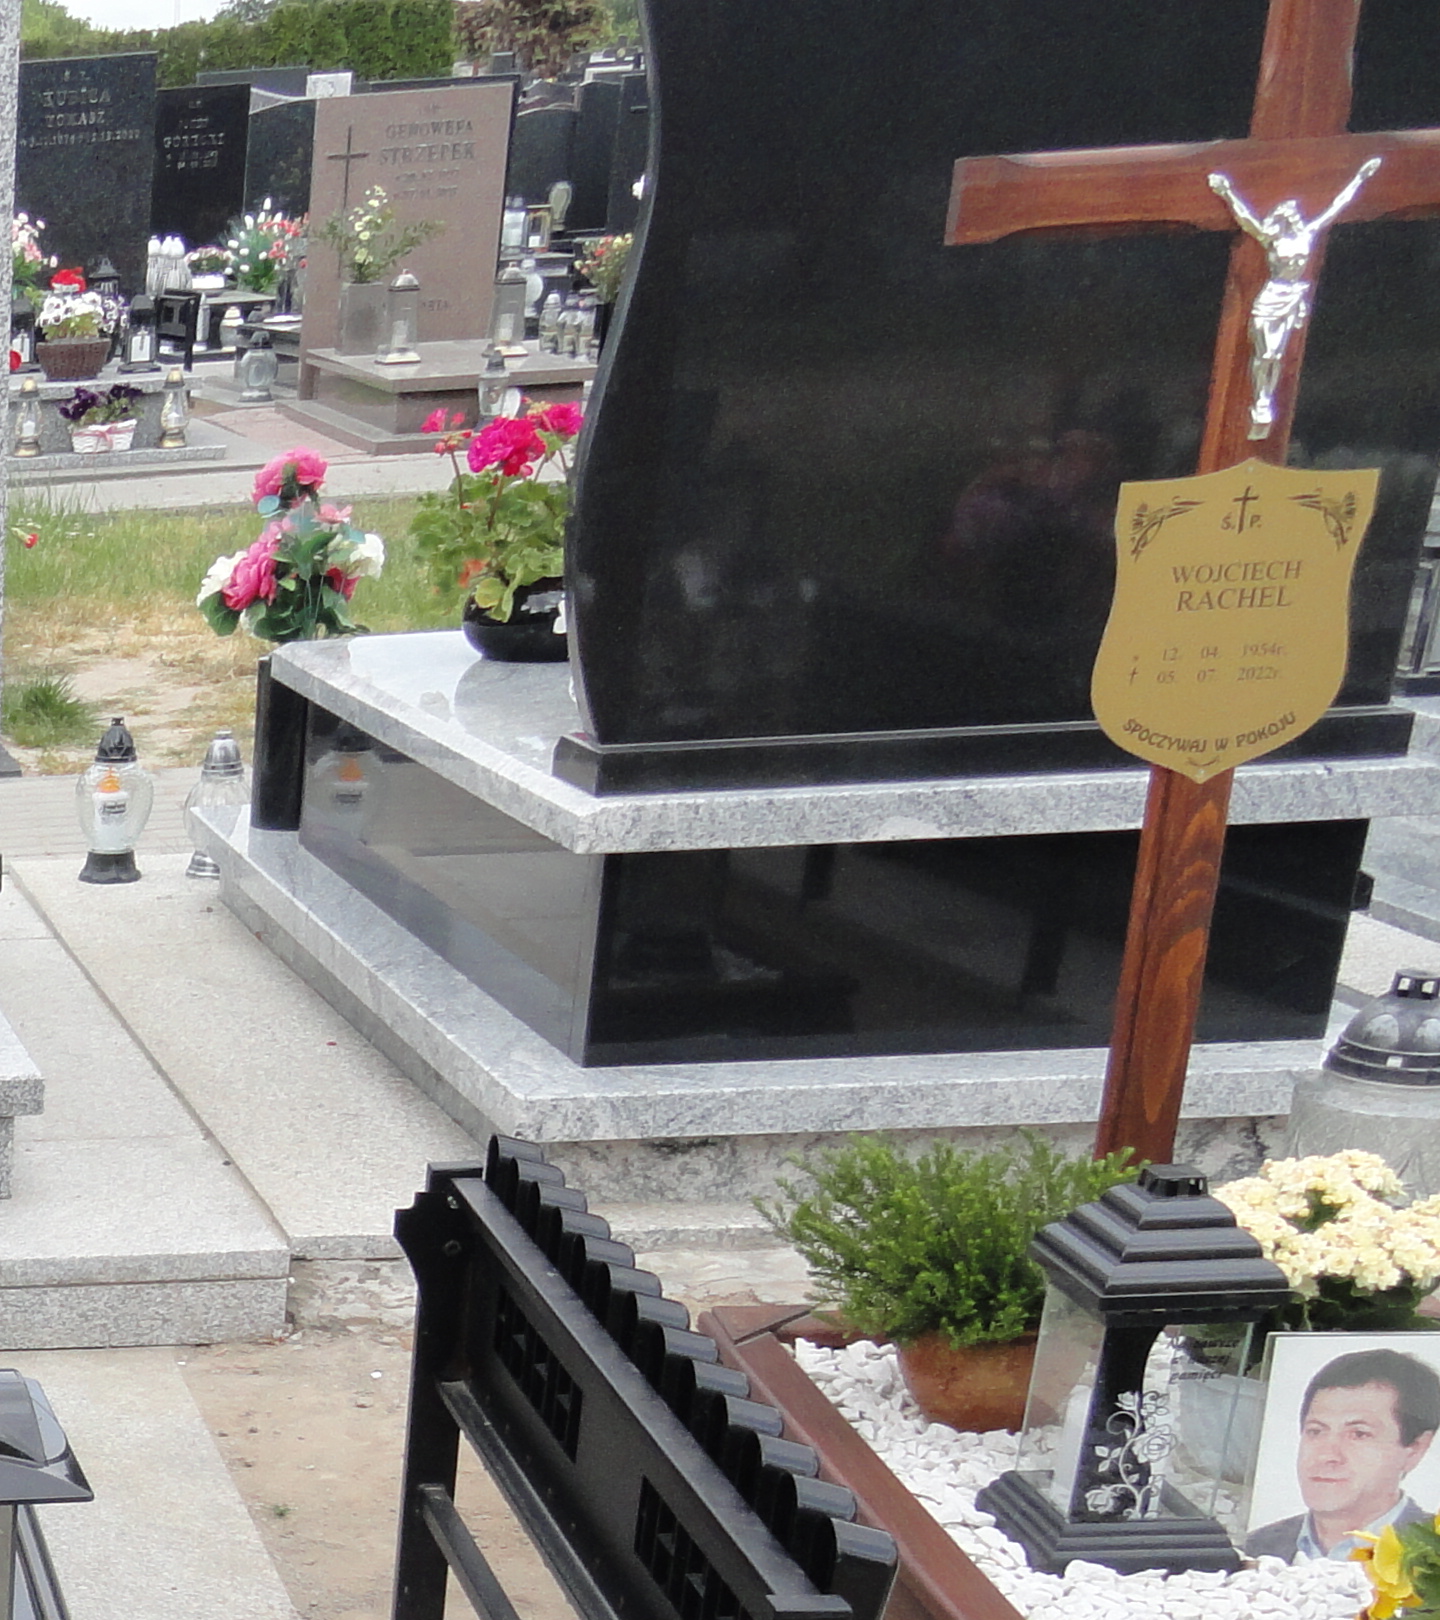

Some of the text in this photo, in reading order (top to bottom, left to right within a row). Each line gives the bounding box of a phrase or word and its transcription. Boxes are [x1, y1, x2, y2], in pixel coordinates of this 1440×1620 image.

[1172, 559, 1303, 584] WOJCIECH
[1176, 584, 1294, 612] RACHEL
[1122, 710, 1296, 753] SPOCZYWAJ W POKOJU
